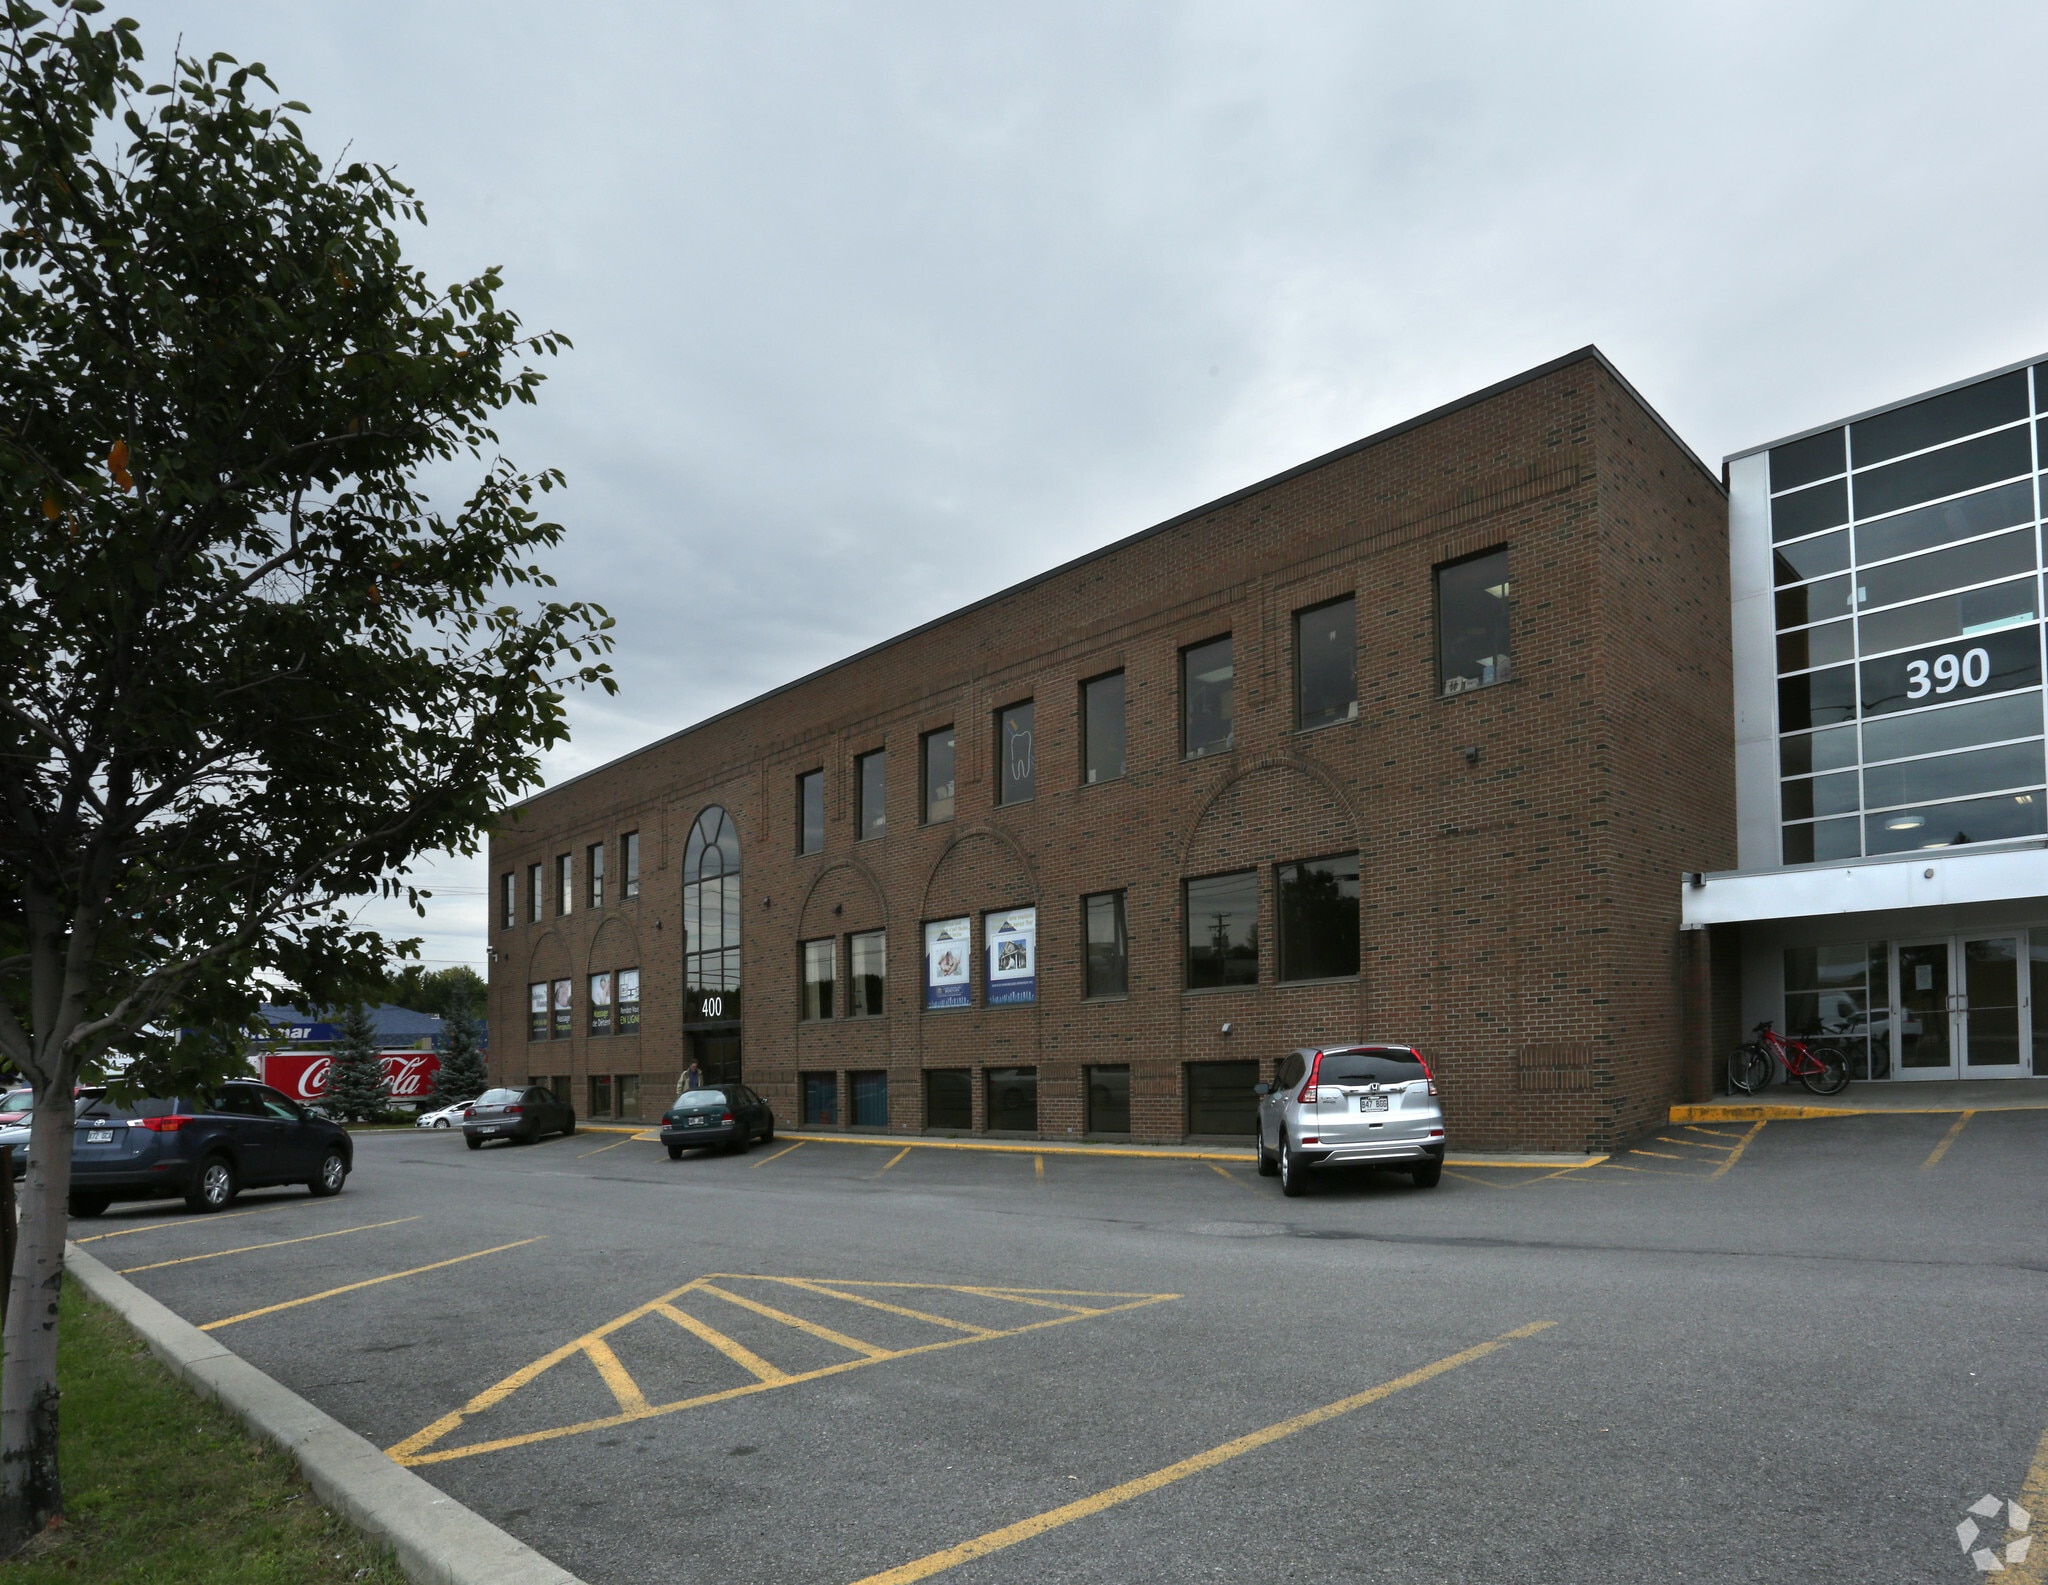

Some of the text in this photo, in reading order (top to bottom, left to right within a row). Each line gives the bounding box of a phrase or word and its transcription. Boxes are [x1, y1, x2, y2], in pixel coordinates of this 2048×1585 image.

[1906, 647, 1990, 699] 390
[702, 996, 722, 1017] 400
[620, 1014, 640, 1025] EN LIGN
